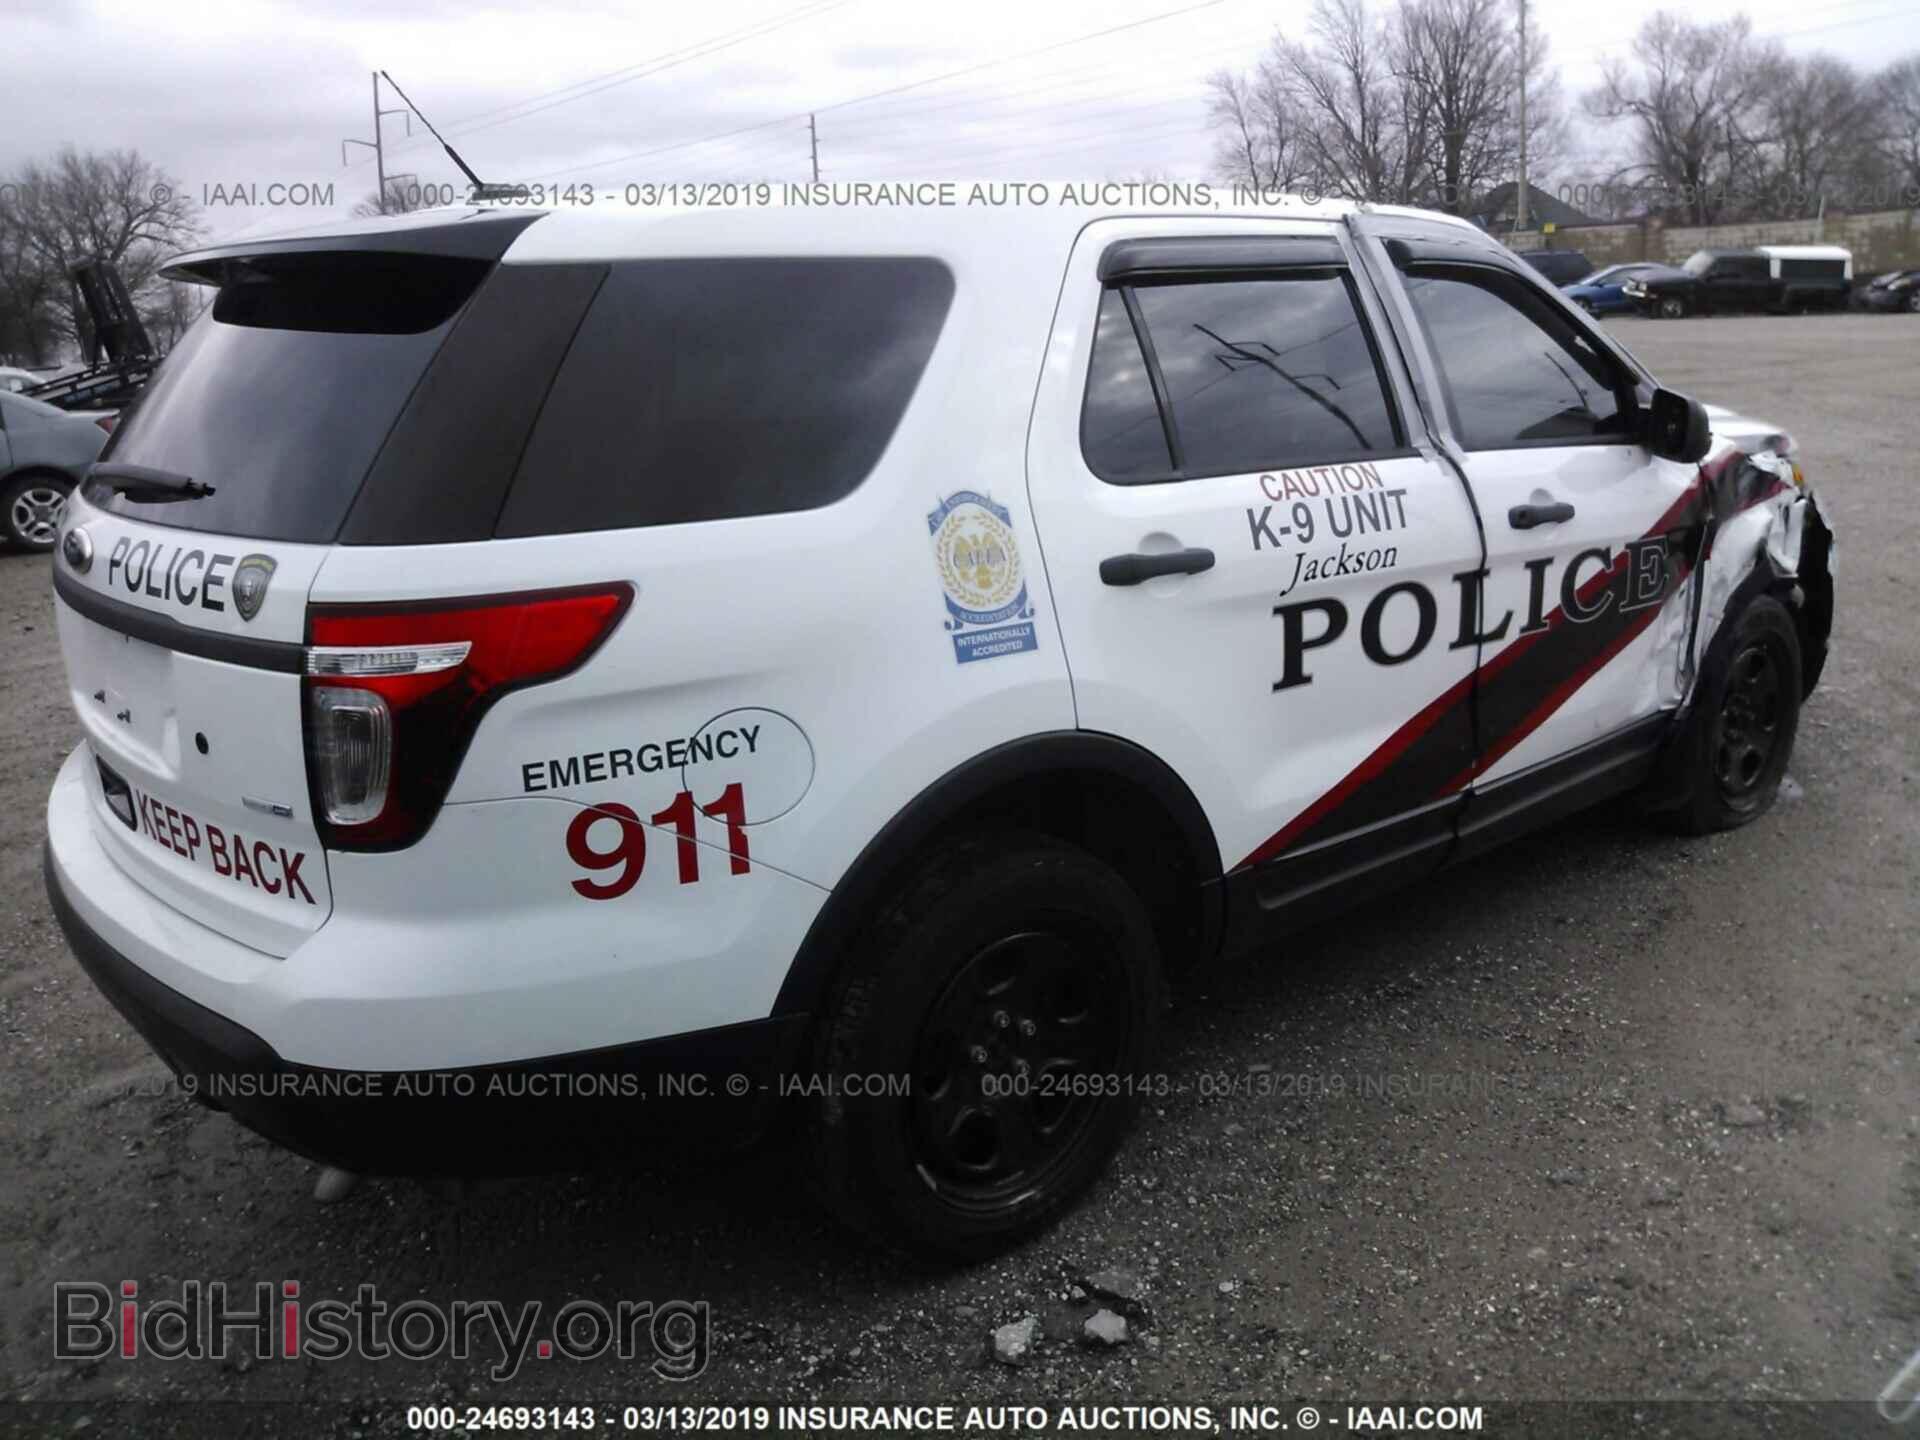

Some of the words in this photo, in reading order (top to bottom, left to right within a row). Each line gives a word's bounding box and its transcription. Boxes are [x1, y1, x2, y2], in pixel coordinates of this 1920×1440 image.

[1259, 463, 1384, 502] CAUTION
[1246, 502, 1314, 550] K-9
[1325, 489, 1407, 538] UNIT
[108, 536, 236, 612] POLICE
[1279, 543, 1397, 597] Jackson
[957, 626, 1031, 648] INTERNATIONALLY
[1271, 538, 1671, 693] POLICE
[971, 641, 1023, 658] ACCREDITED
[522, 725, 761, 793] EMERGENCY
[136, 788, 201, 862] KEEP
[206, 823, 317, 905] BACK
[566, 782, 751, 901] 911
